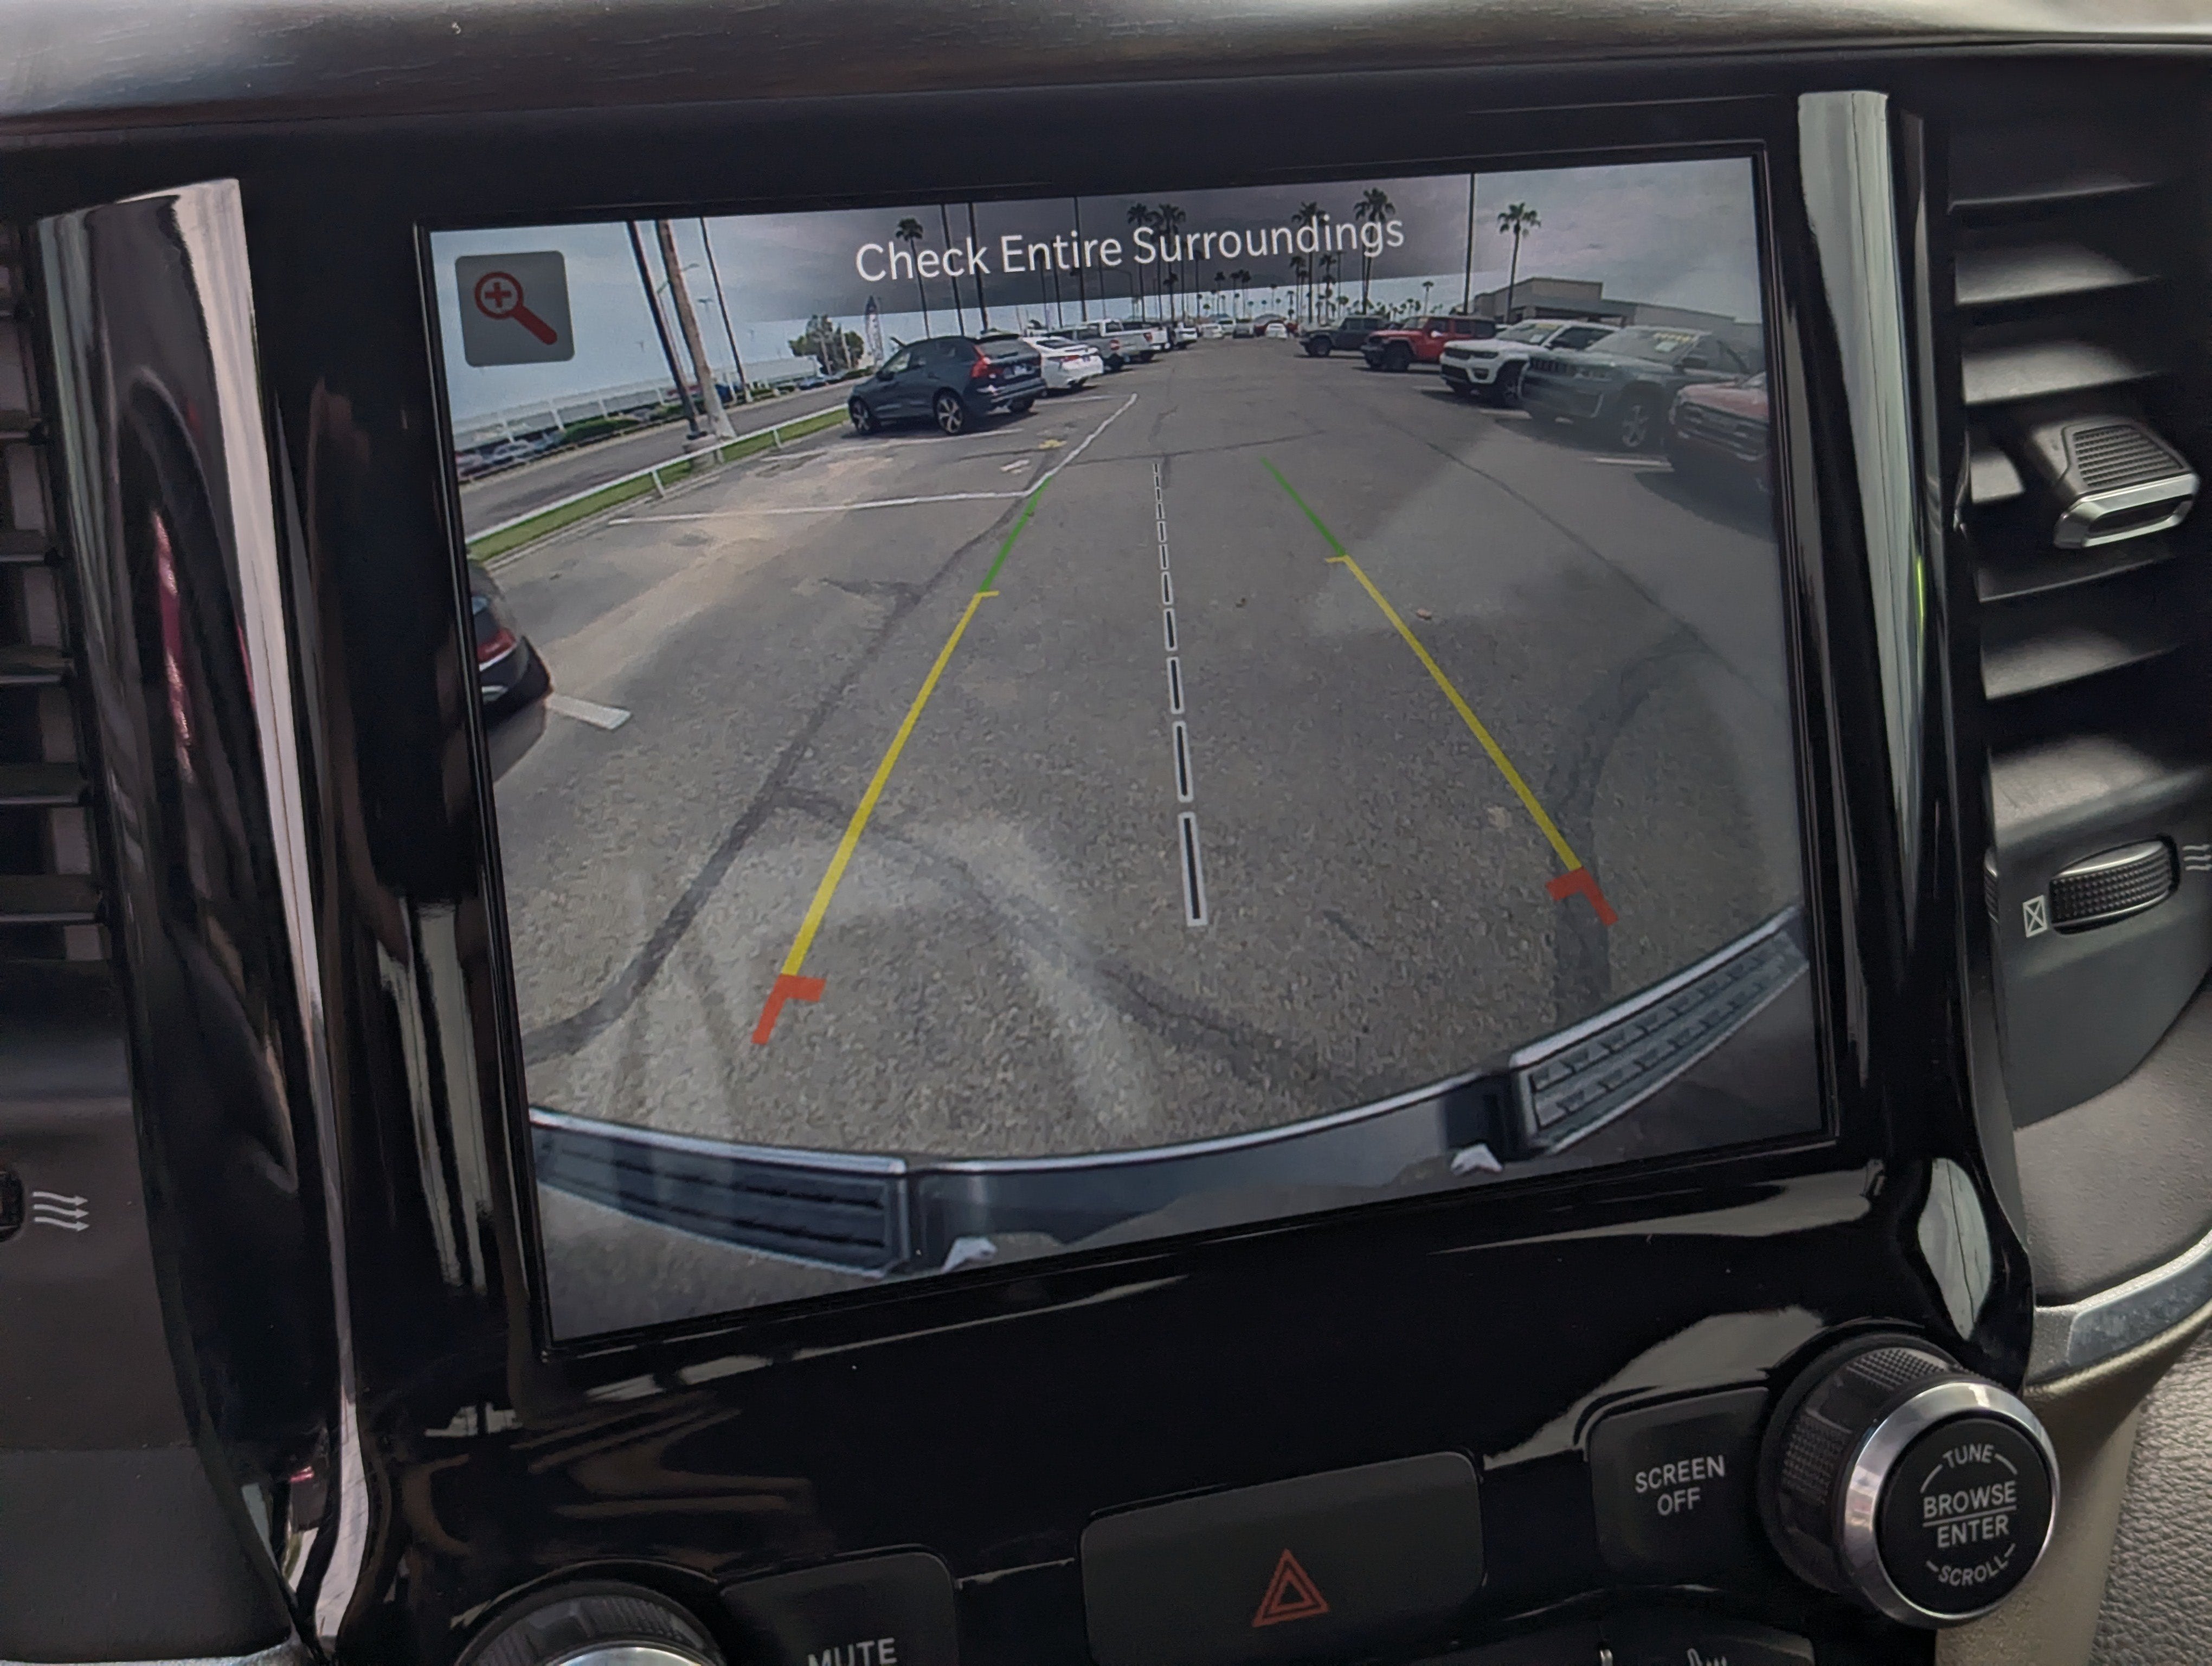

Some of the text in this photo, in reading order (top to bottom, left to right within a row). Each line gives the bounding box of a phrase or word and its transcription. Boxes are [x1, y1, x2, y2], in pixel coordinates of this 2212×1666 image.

[854, 215, 1405, 281] Check Entire Surroundings
[1943, 1444, 1995, 1468] TUNE
[1635, 1455, 1726, 1494] SCREEN
[1657, 1488, 1701, 1516] OFF
[1923, 1481, 2017, 1517] BROWSE
[1937, 1515, 2009, 1548] ENTER
[1938, 1554, 2009, 1586] SCROLL
